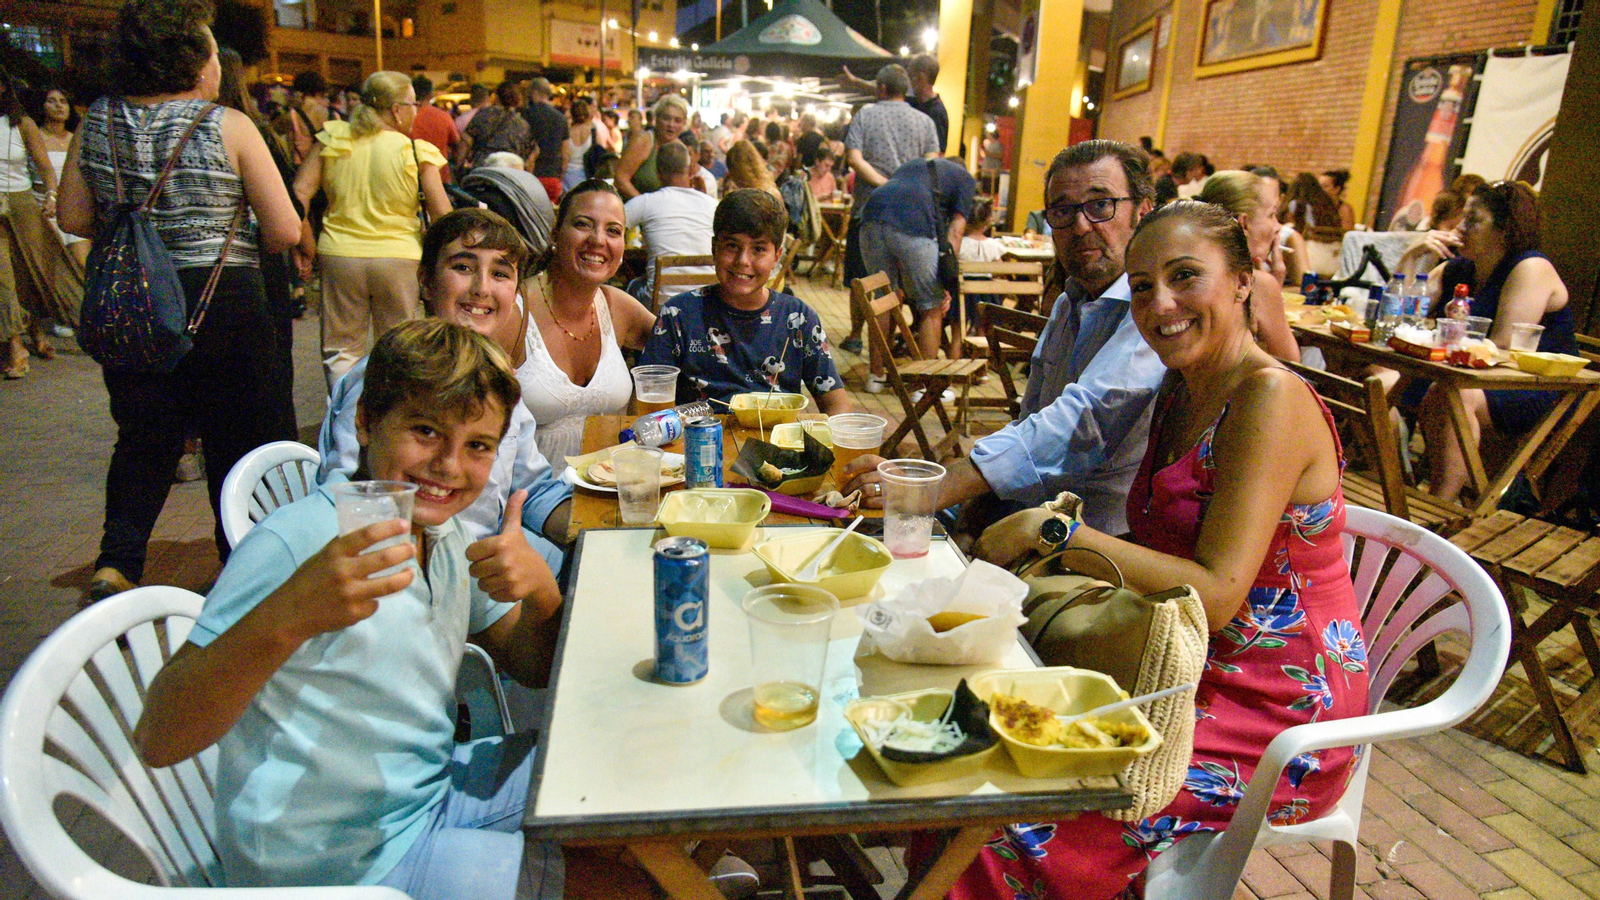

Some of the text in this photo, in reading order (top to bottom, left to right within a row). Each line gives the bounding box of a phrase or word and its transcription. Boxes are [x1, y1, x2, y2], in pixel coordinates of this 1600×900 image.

[693, 55, 733, 70] Galicia
[690, 339, 702, 347] JOE
[688, 345, 707, 353] COOL
